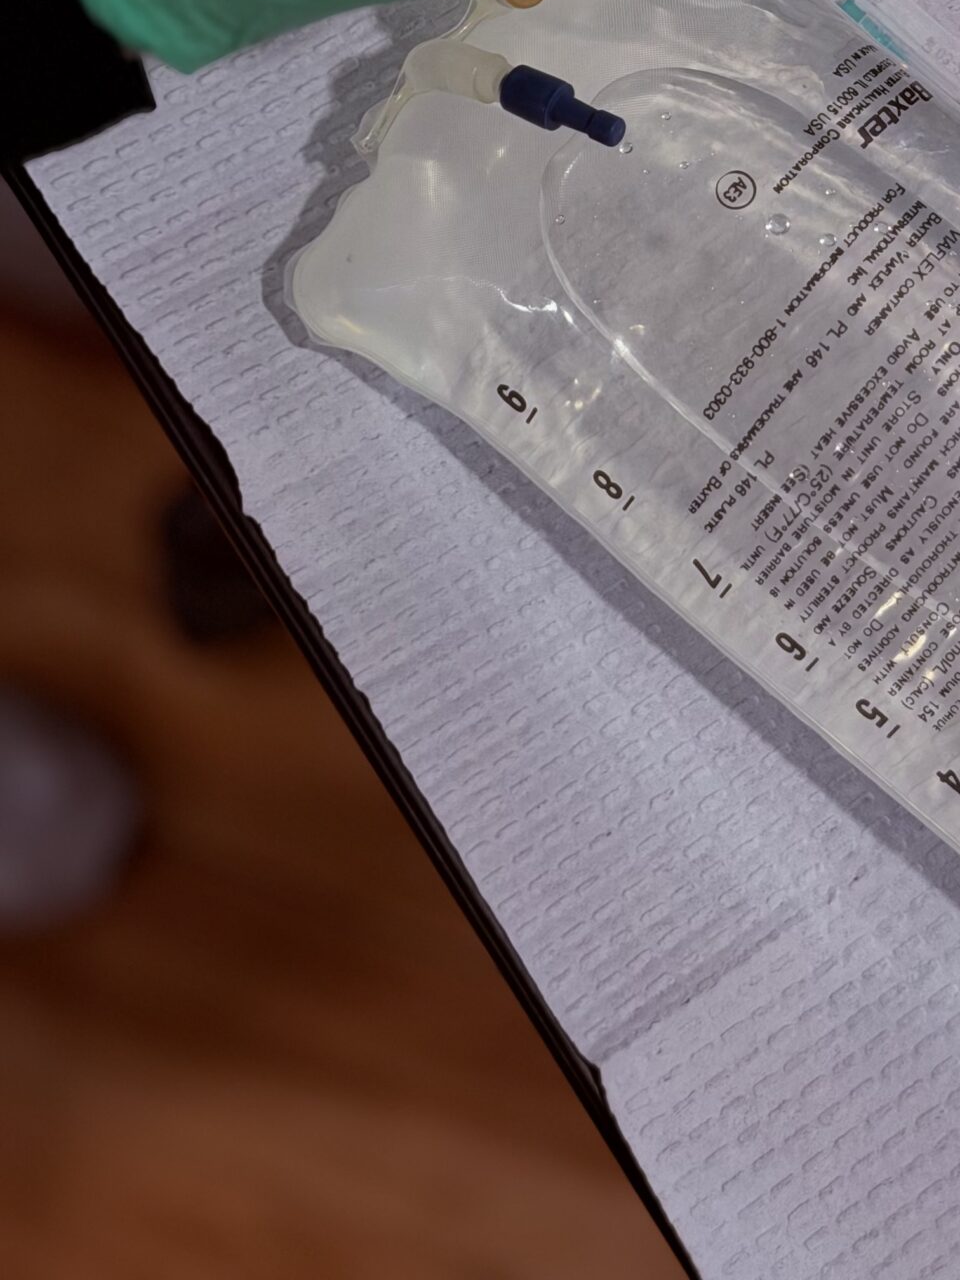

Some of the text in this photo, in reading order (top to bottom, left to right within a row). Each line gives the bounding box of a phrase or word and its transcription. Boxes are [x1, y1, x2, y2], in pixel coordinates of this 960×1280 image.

[832, 58, 856, 78] USA
[826, 86, 859, 116] 60015
[803, 112, 830, 137] USA
[855, 79, 933, 152] Baxter
[722, 177, 747, 203] AE3
[826, 319, 848, 339] PL
[805, 342, 830, 368] 146
[701, 318, 788, 421] 1-800-933-0303
[497, 382, 527, 414] 9
[753, 450, 775, 470] PL
[592, 469, 624, 501] 8
[734, 471, 757, 497] 146
[692, 559, 722, 589] 7
[775, 631, 808, 663] 6
[855, 698, 888, 729] 5
[917, 701, 939, 722] 154
